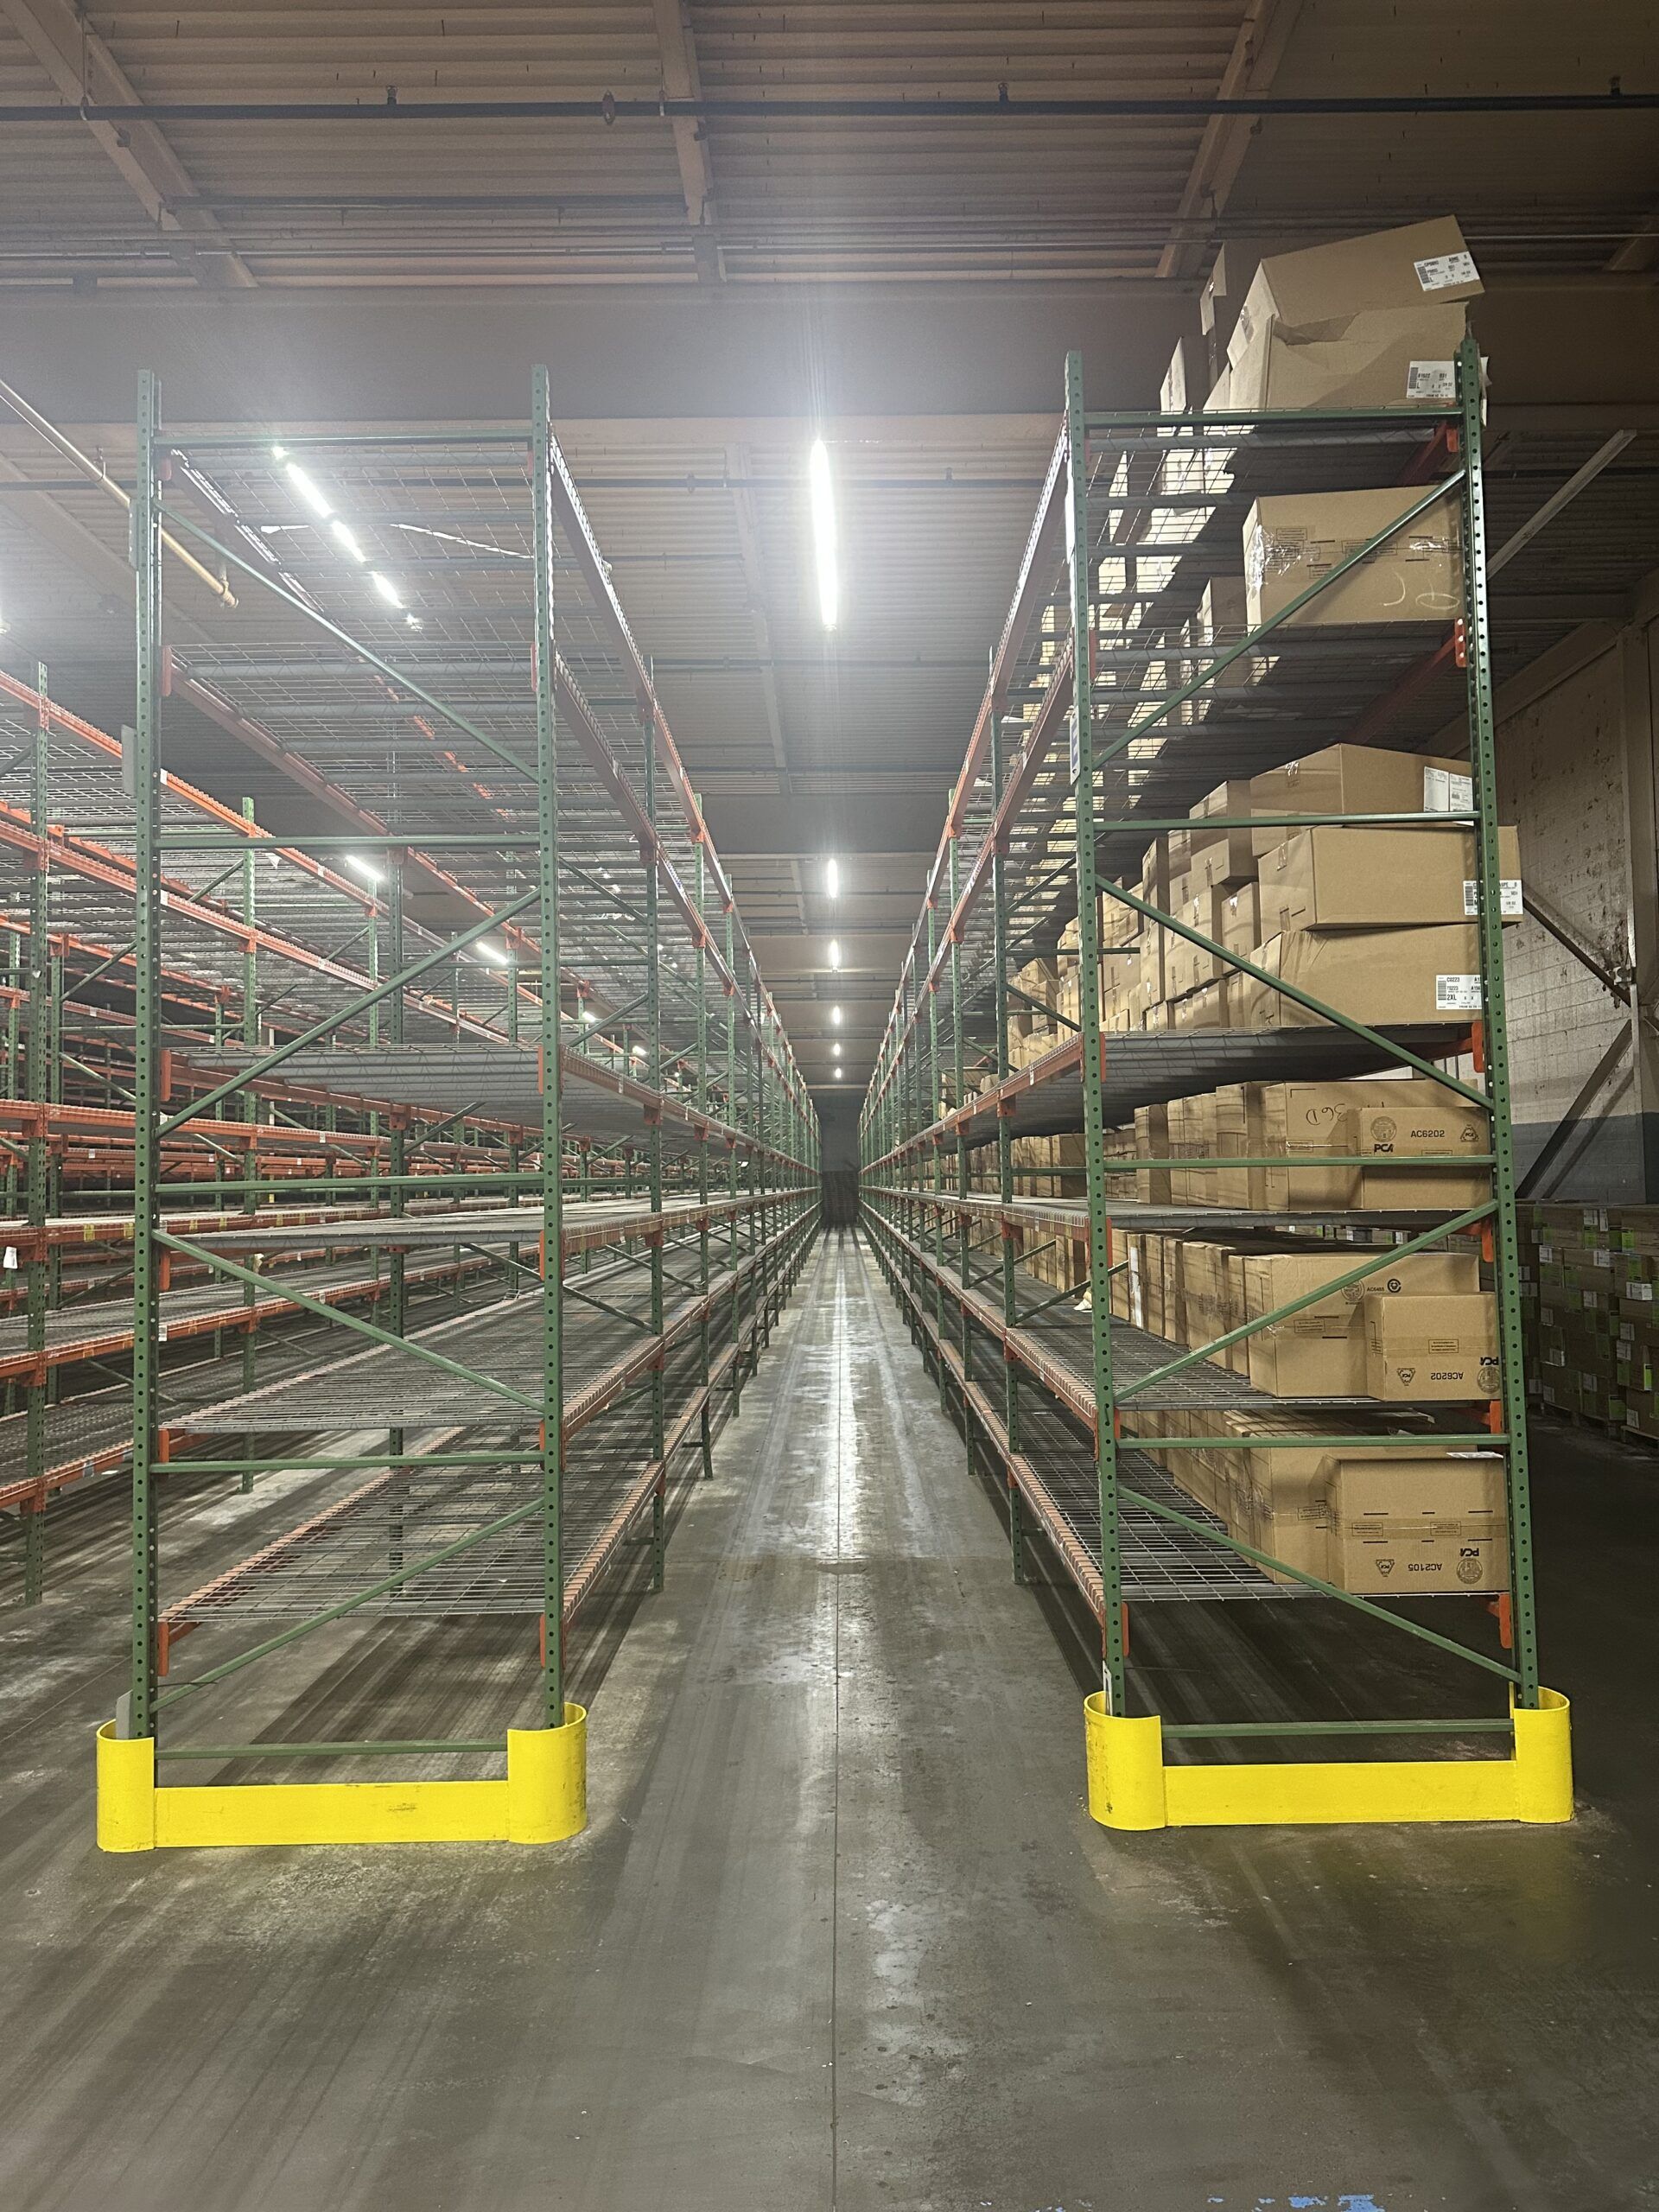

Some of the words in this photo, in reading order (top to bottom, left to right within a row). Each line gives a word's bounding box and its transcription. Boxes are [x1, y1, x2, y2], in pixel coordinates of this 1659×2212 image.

[1374, 1143, 1394, 1153] PCA
[1479, 1357, 1499, 1365] PCA
[1430, 1371, 1465, 1380] AC6202
[1459, 1548, 1479, 1557] PCA
